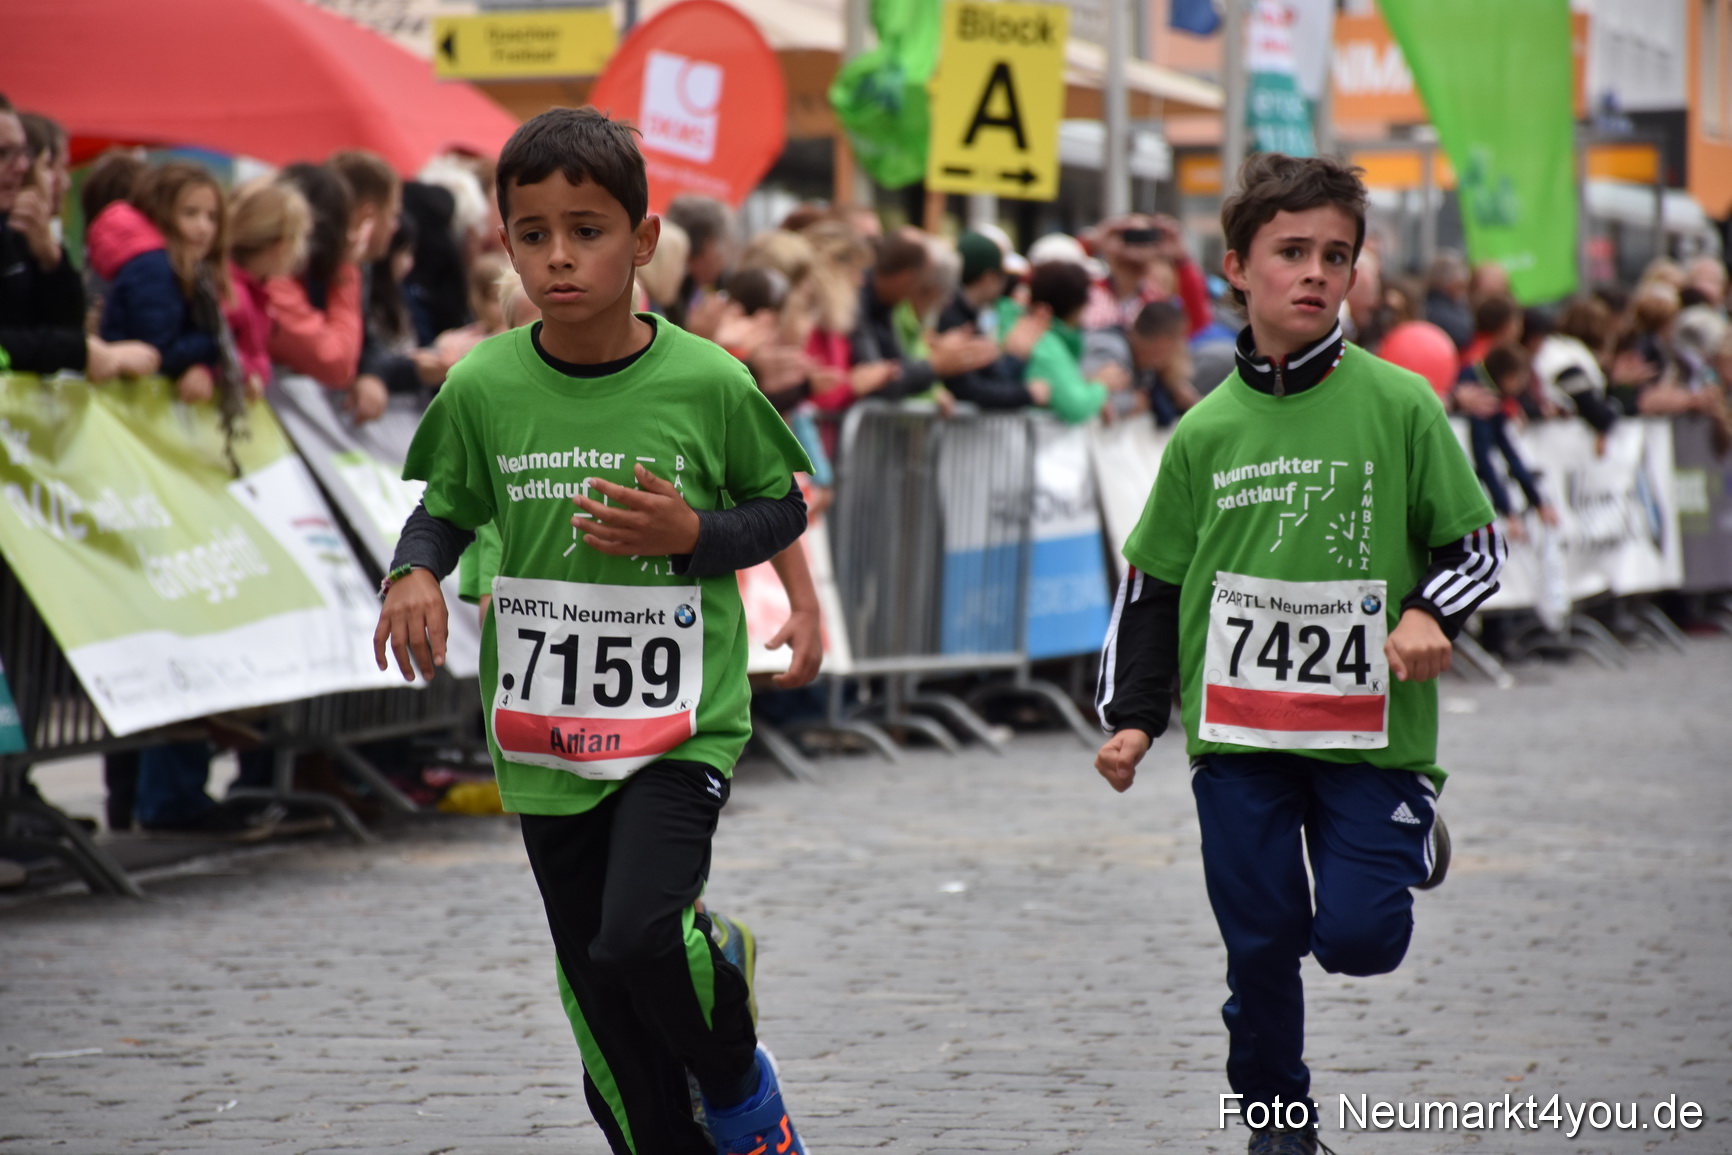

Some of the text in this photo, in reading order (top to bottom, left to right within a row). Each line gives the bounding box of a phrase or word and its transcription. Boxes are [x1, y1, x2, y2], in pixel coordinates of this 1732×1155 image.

[957, 5, 1054, 45] Block
[963, 61, 1029, 150] A
[496, 446, 625, 474] Neumarkter
[1213, 456, 1322, 490] Neumarkter
[1359, 461, 1374, 570] BAMBINI
[498, 597, 666, 625] PARTL Neumarkt
[1216, 589, 1266, 609] PARTL
[1270, 597, 1353, 615] Neumarkt
[518, 628, 681, 708] 7159
[1226, 617, 1371, 685] 7424
[1372, 681, 1378, 691] K
[550, 726, 621, 754] Arian
